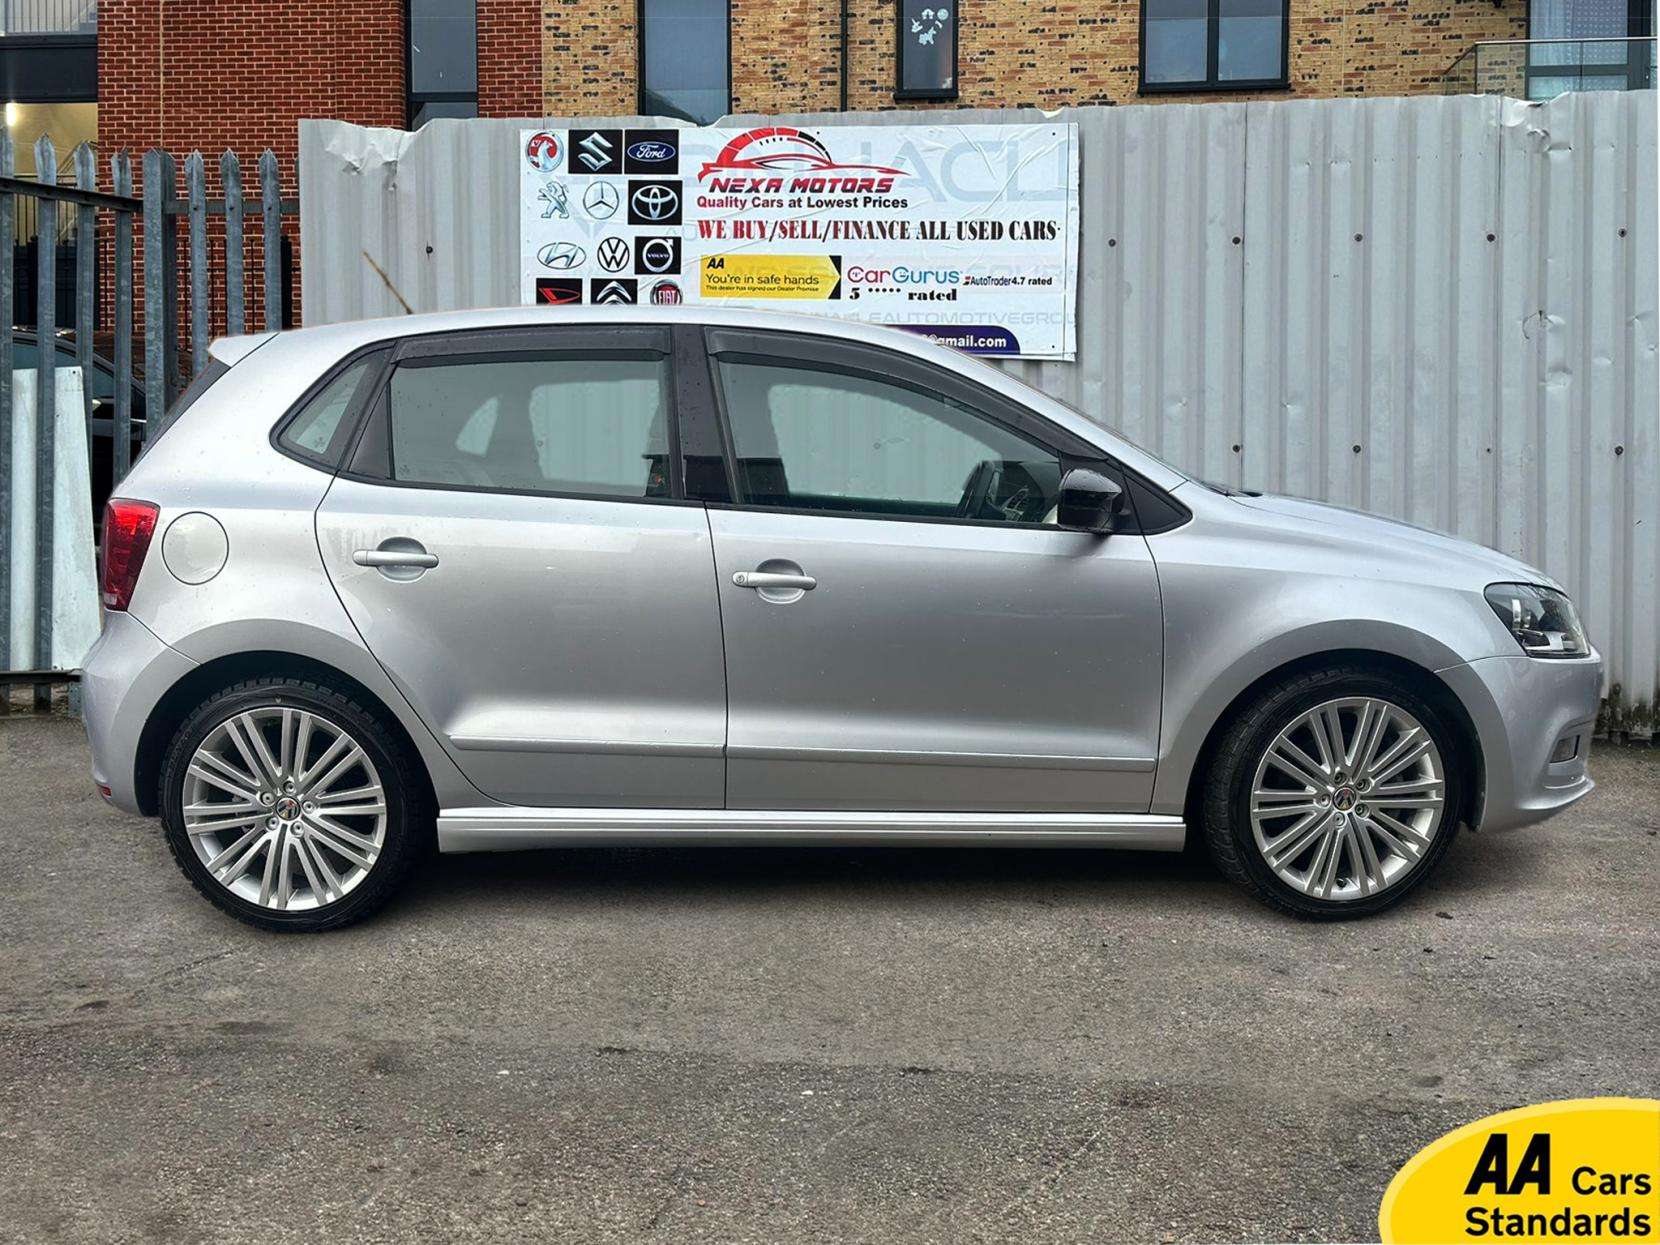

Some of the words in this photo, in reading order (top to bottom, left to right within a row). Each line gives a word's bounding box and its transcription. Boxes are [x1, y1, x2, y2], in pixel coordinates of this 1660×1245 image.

[636, 144, 665, 158] Ford
[709, 178, 783, 193] NEXA
[789, 178, 894, 193] MOTORS
[697, 196, 746, 210] Quality
[752, 196, 783, 208] Cars
[788, 197, 803, 208] at
[807, 196, 858, 208] Lowest
[863, 196, 908, 208] Prices
[698, 220, 726, 239] WE
[917, 221, 950, 240] ALL
[956, 220, 1004, 240] USED
[707, 258, 725, 269] AA
[706, 274, 740, 284] You're
[744, 274, 754, 283] in
[757, 274, 782, 284] safe
[784, 275, 820, 285] hands
[847, 266, 960, 284] CarGurus
[1028, 277, 1053, 285] rated
[658, 290, 676, 305] FIAT
[850, 288, 860, 300] 5
[908, 289, 957, 301] rated
